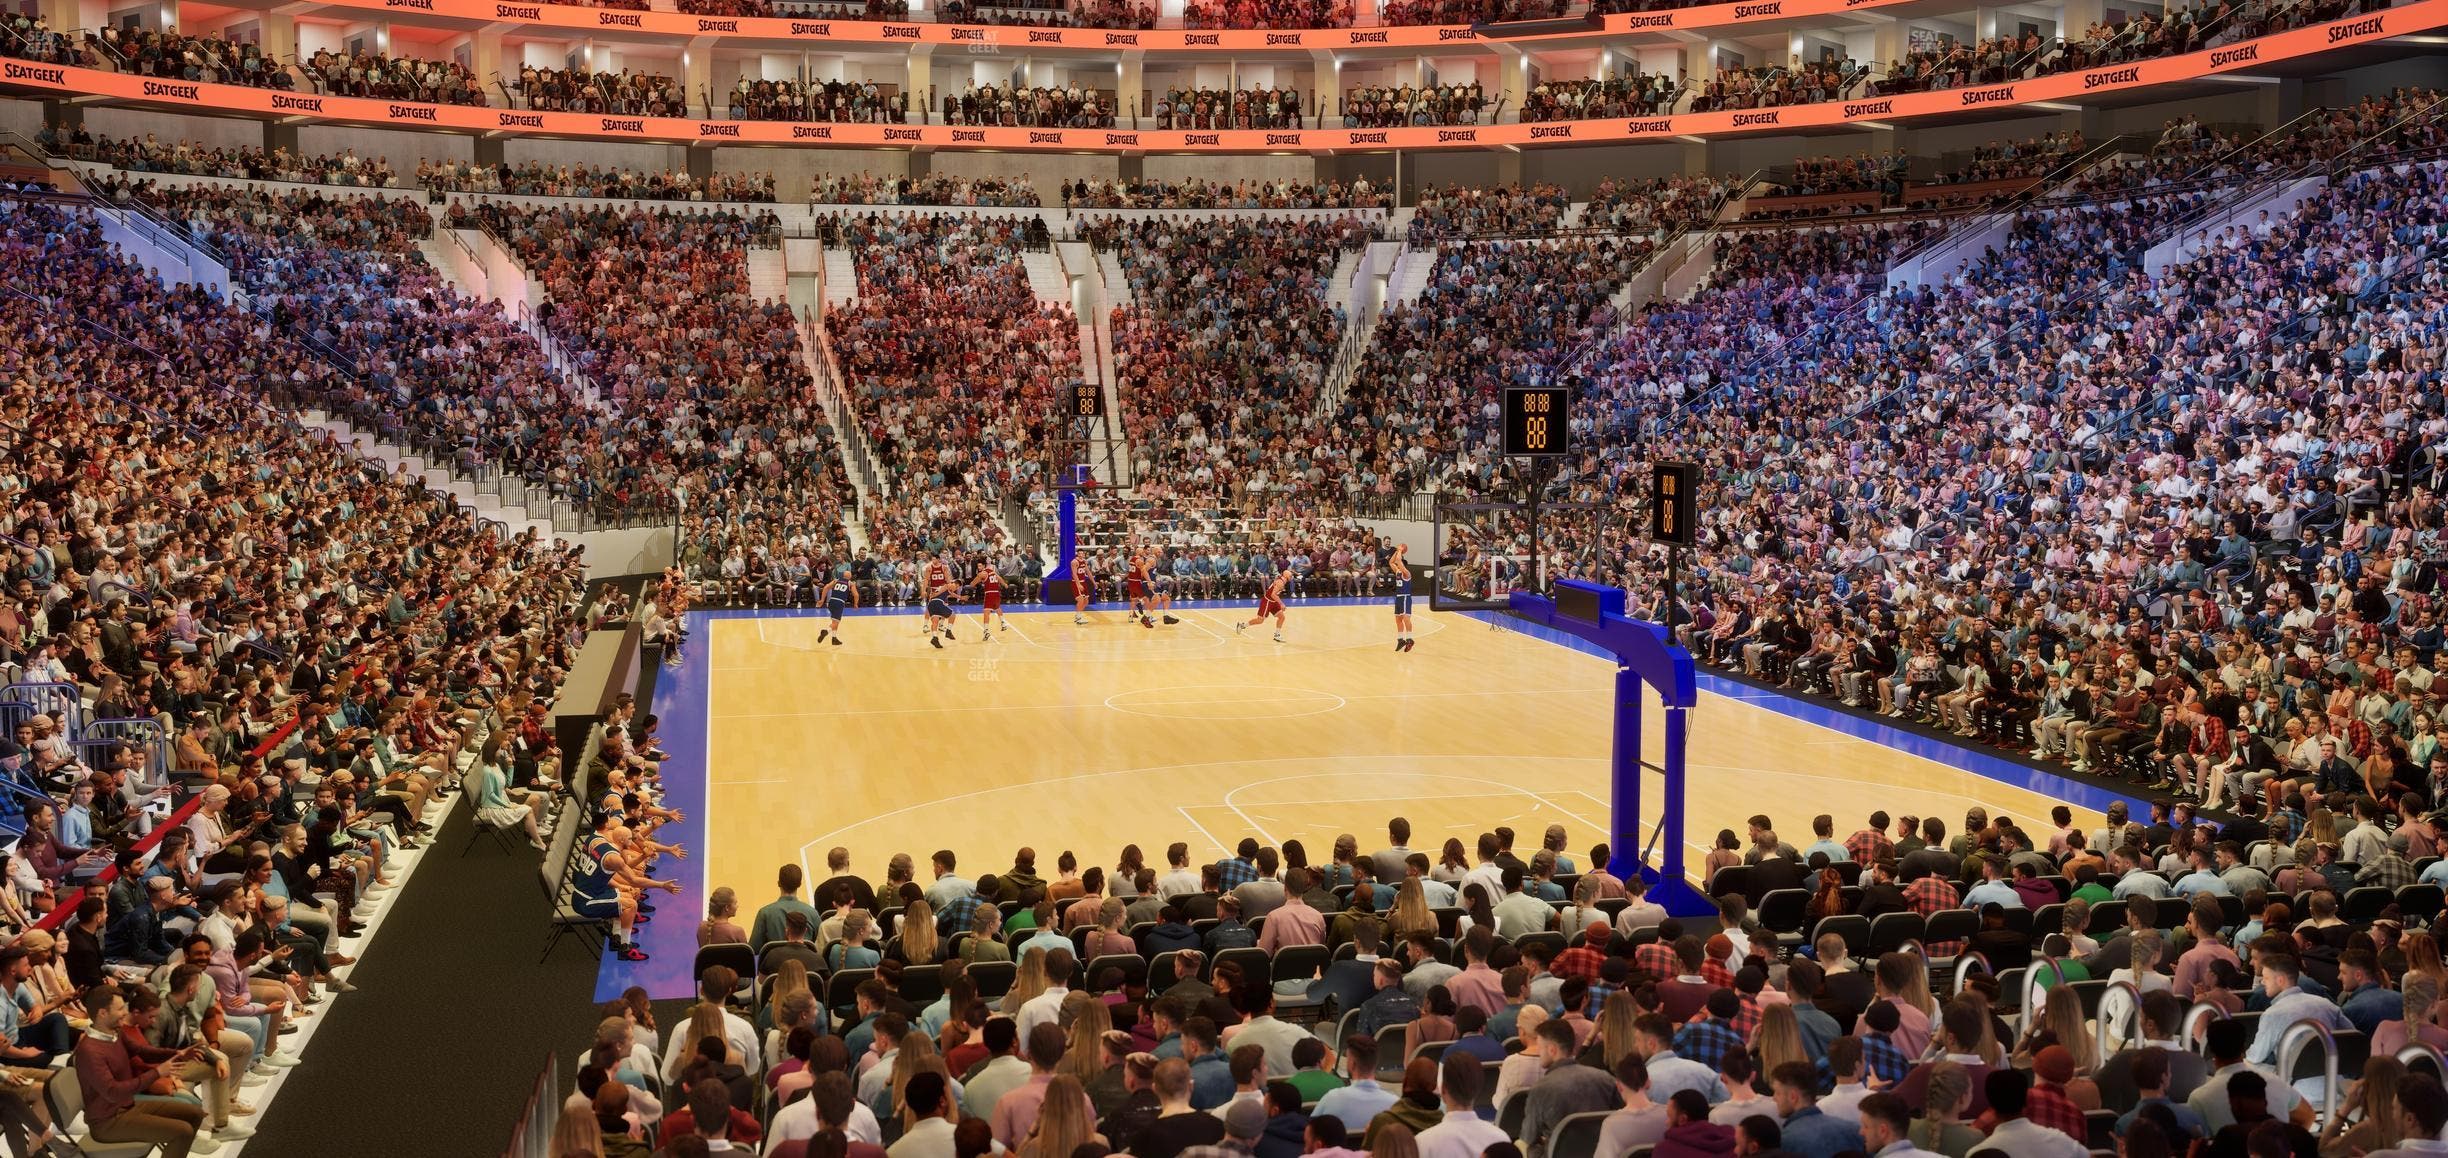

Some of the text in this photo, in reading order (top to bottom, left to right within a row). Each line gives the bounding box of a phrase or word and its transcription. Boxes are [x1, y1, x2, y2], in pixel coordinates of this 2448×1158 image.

[497, 5, 541, 20] SEATGEEK
[1734, 2, 1781, 18] SEATGEEK
[600, 12, 641, 27] SEATGEEK
[699, 19, 738, 33] SEATGEEK
[1631, 14, 1673, 28] SEATGEEK
[791, 22, 831, 37] SEATGEEK
[882, 25, 921, 39] SEATGEEK
[951, 28, 984, 40] SEATGEEK
[1439, 29, 1477, 40] SEATGEEK
[2328, 16, 2384, 43] SEATGEEK
[1029, 30, 1062, 44] SEATGEEK
[1105, 33, 1138, 46] SEATGEEK
[1185, 33, 1219, 46] SEATGEEK
[1267, 33, 1301, 46] SEATGEEK
[1350, 31, 1388, 44] SEATGEEK
[2210, 43, 2258, 68] SEATGEEK
[5, 63, 66, 86] SEATGEEK
[2084, 67, 2140, 90] SEATGEEK
[143, 80, 199, 101] SEATGEEK
[1961, 86, 2014, 106] SEATGEEK
[271, 94, 323, 113] SEATGEEK
[1843, 100, 1893, 119] SEATGEEK
[389, 104, 437, 122] SEATGEEK
[1732, 110, 1779, 128] SEATGEEK
[499, 112, 544, 129] SEATGEEK
[601, 118, 644, 134] SEATGEEK
[1628, 119, 1672, 135] SEATGEEK
[700, 123, 740, 137] SEATGEEK
[792, 126, 832, 140] SEATGEEK
[883, 128, 922, 142] SEATGEEK
[952, 130, 986, 143] SEATGEEK
[1438, 130, 1477, 143] SEATGEEK
[1530, 125, 1572, 139] SEATGEEK
[1029, 131, 1063, 144] SEATGEEK
[1105, 133, 1139, 146] SEATGEEK
[1184, 134, 1220, 146] SEATGEEK
[1266, 134, 1301, 146] SEATGEEK
[1349, 132, 1388, 145] SEATGEEK
[1080, 398, 1094, 414] 88
[1524, 394, 1549, 412] 88 88
[1527, 417, 1546, 449] 88
